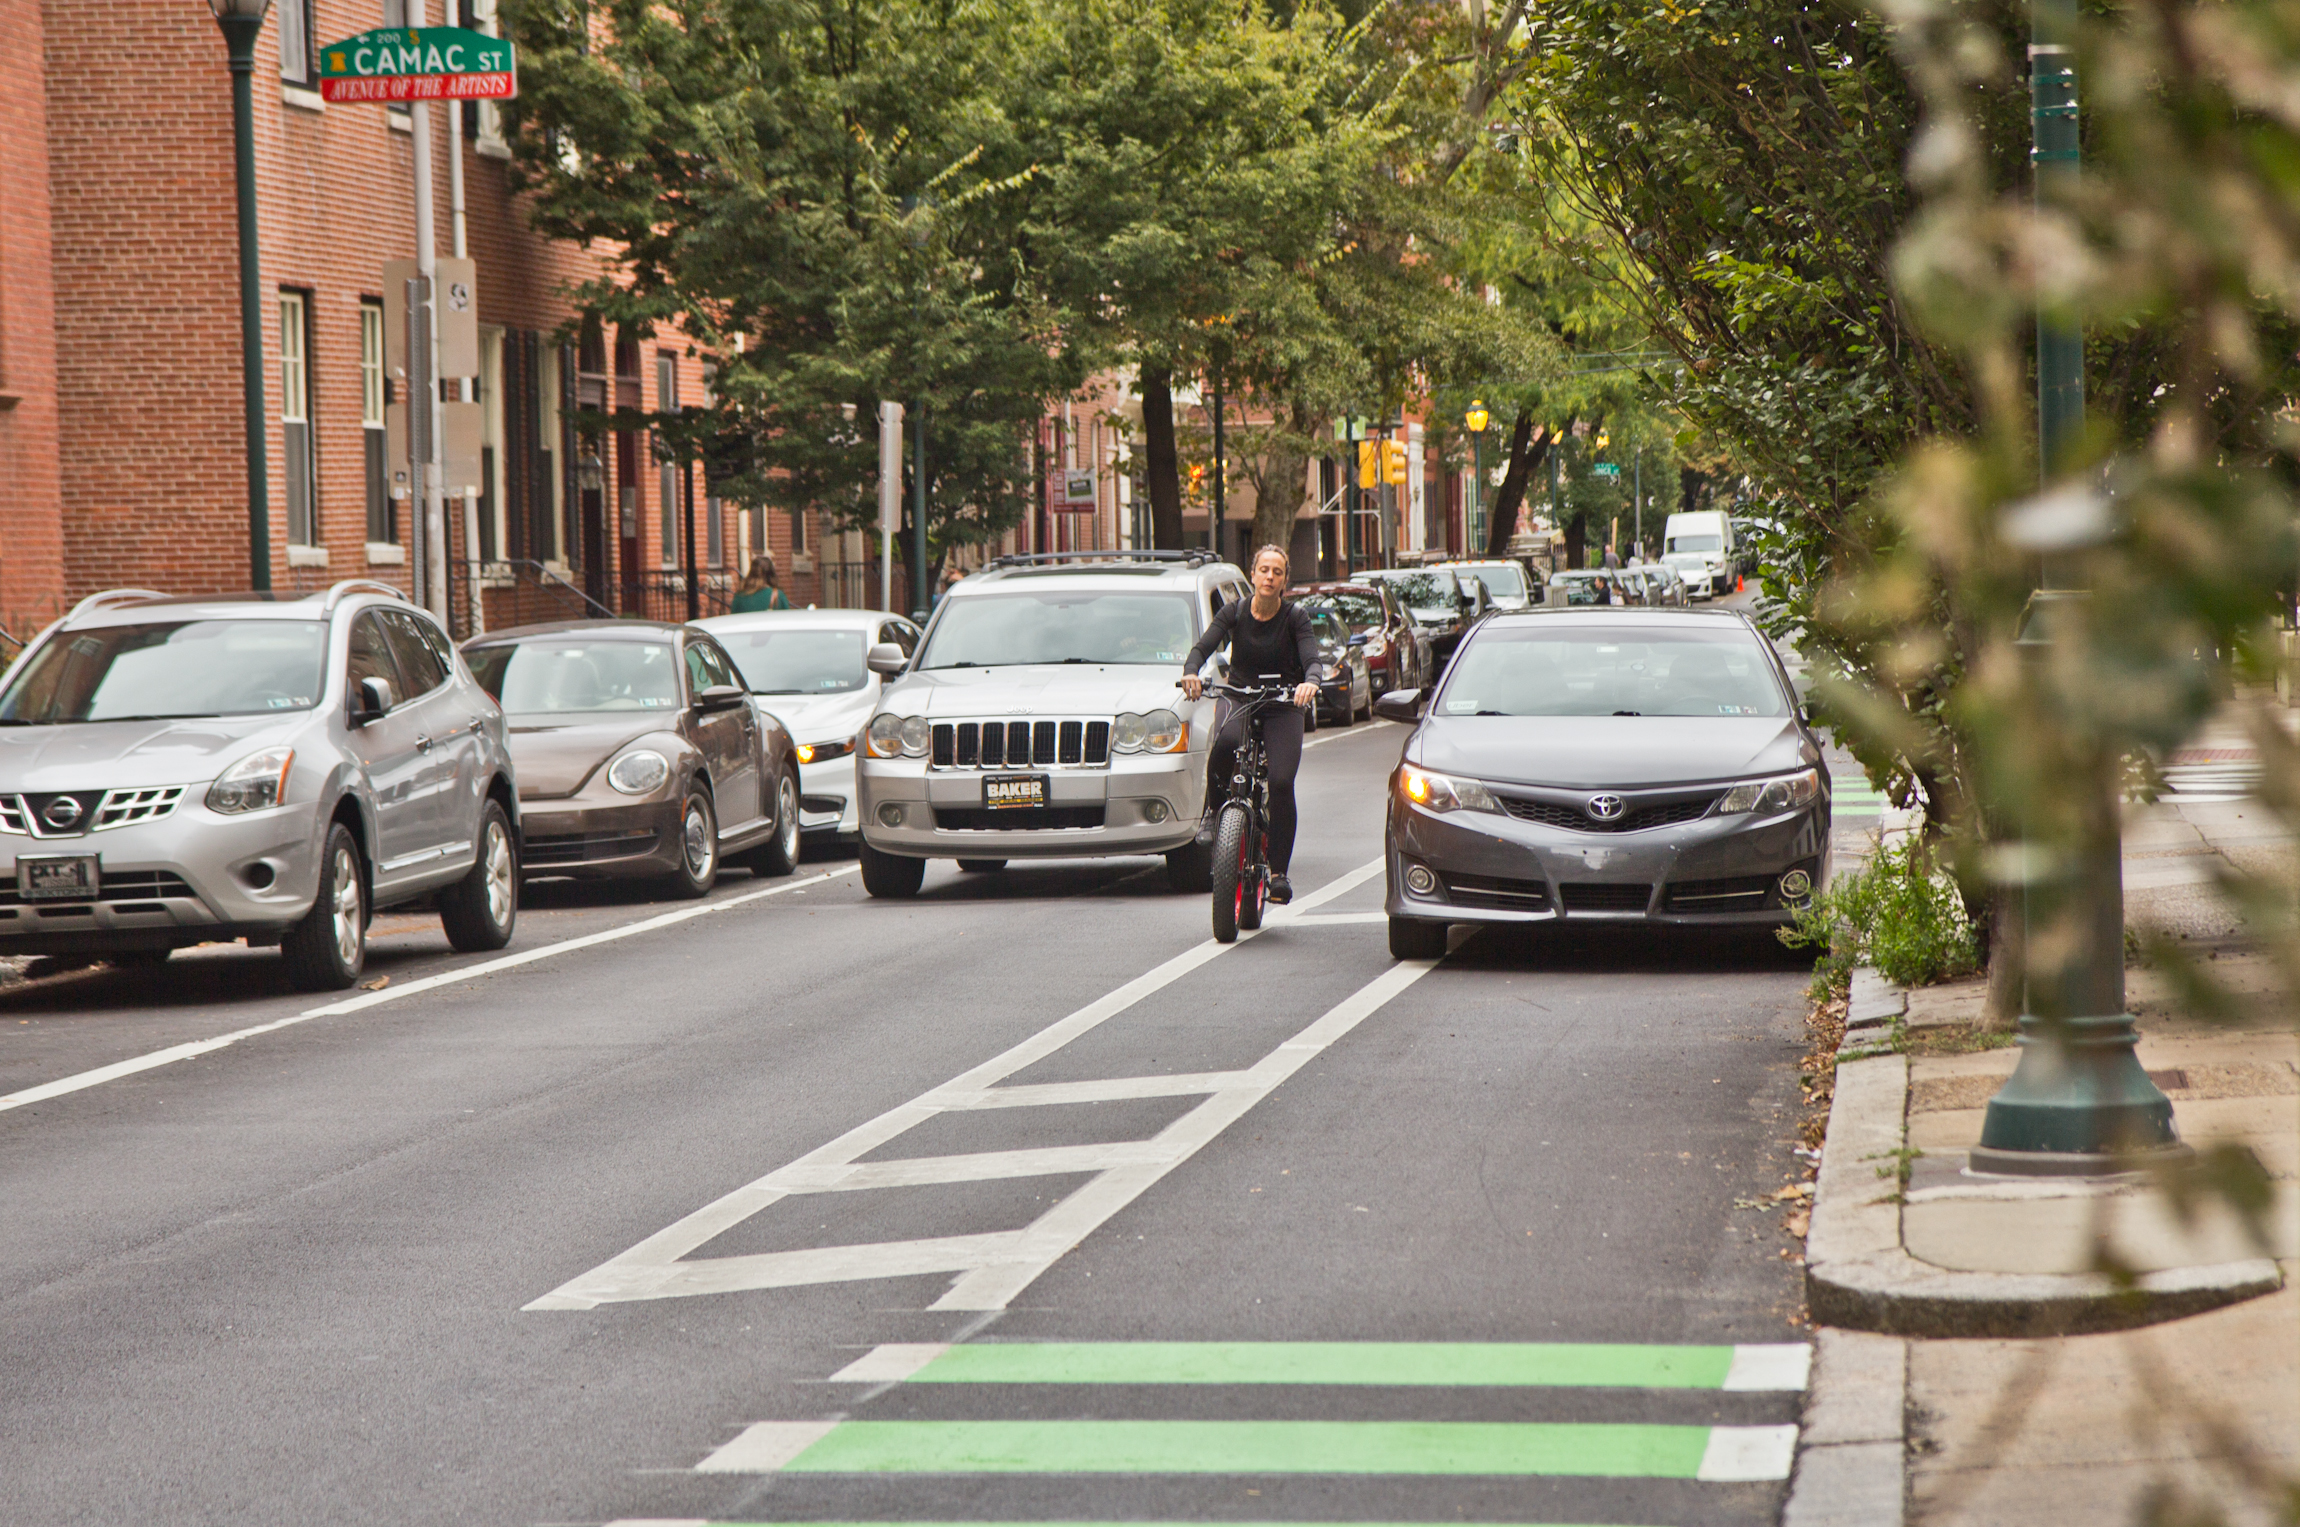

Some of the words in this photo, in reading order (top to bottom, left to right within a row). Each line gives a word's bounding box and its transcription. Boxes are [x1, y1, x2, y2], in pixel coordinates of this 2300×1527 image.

[376, 32, 401, 45] 200
[408, 29, 420, 46] S
[354, 44, 466, 76] CAMAC
[478, 51, 503, 72] ST
[330, 78, 389, 100] AVENUE
[390, 78, 411, 98] OF
[413, 77, 443, 97] THE
[446, 75, 508, 96] ARTISTS
[1006, 705, 1033, 714] Jeep
[987, 781, 1042, 797] BAKER
